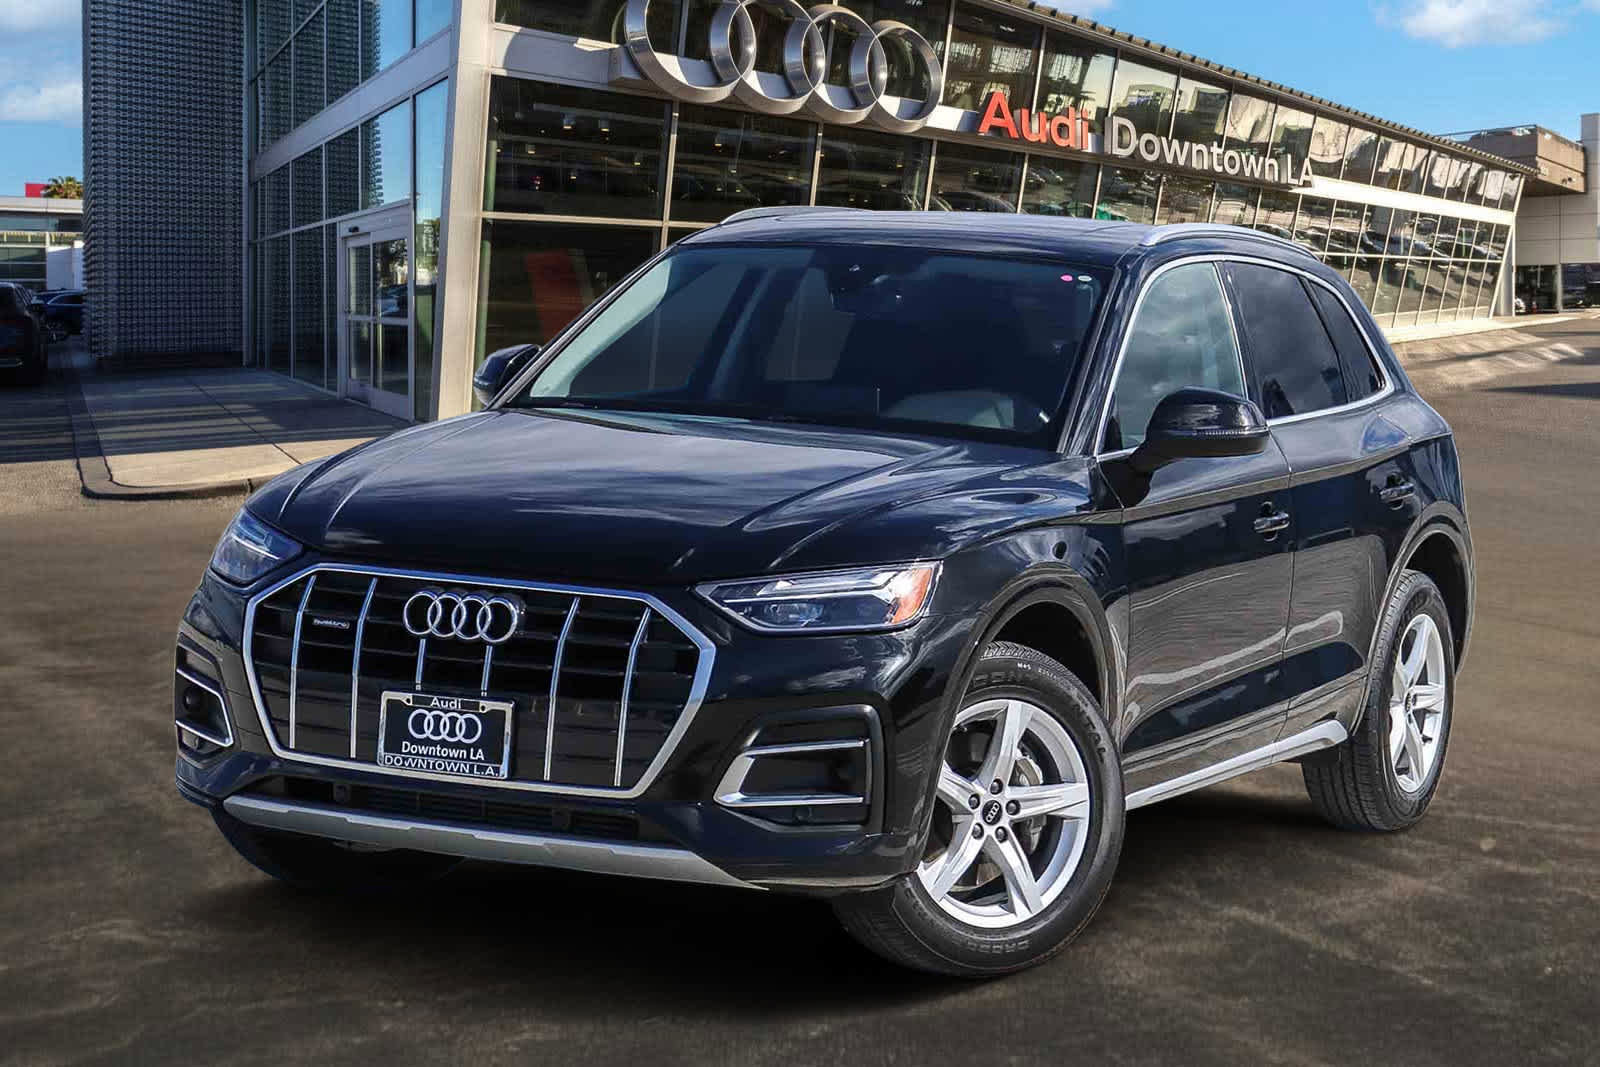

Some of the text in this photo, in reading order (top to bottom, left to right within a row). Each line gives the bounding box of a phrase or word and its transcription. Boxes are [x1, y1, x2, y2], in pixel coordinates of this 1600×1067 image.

[978, 91, 1315, 188] Audi Downtown LA
[430, 697, 462, 710] Audi
[401, 741, 485, 761] Downtown LA
[384, 755, 499, 777] DOWNTOWN L.A.
